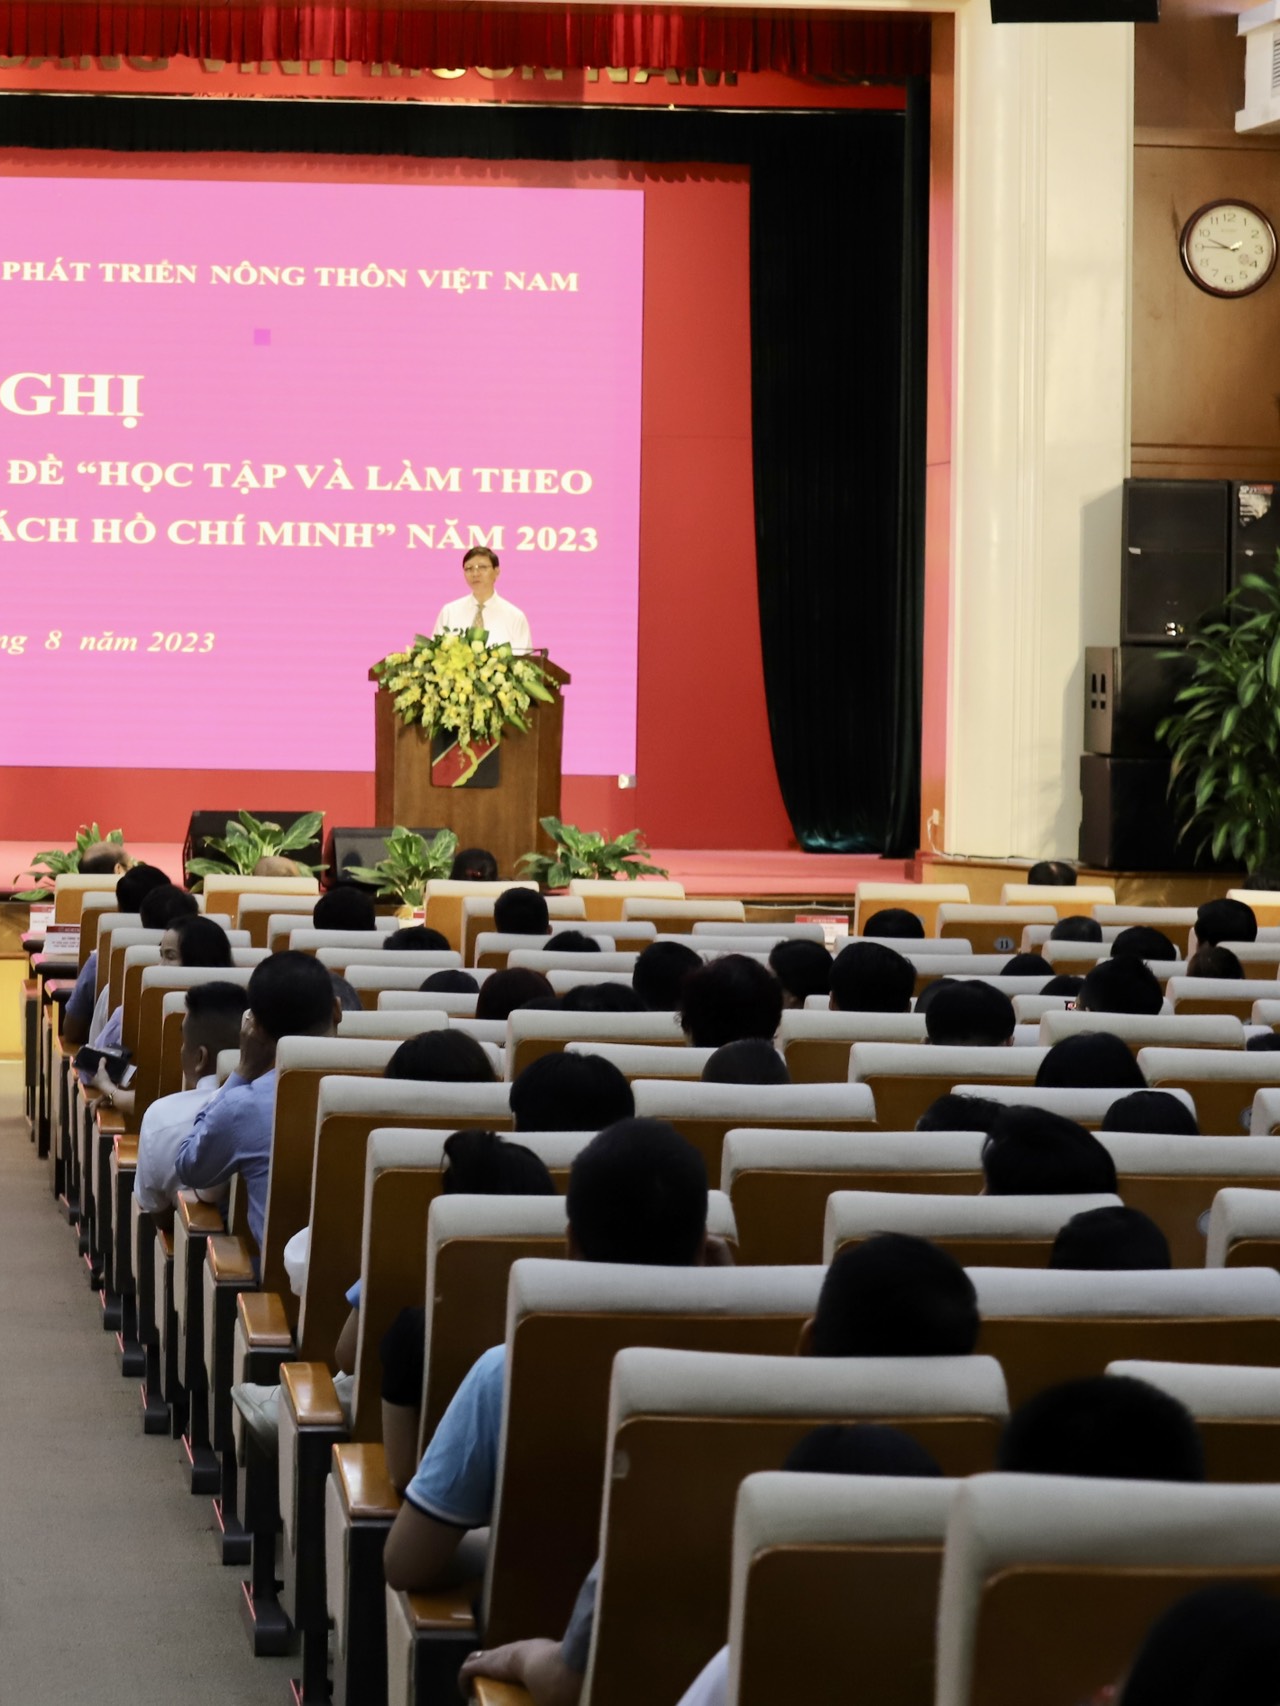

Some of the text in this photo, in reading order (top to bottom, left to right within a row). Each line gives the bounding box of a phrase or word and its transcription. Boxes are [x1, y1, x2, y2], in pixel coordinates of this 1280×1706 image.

[1, 256, 92, 282] PHÁT
[98, 259, 198, 284] TRIỂN
[210, 260, 306, 287] NÔNG
[313, 262, 408, 288] THÔN
[417, 266, 494, 295] VIỆT
[503, 270, 579, 293] NAM
[7, 452, 65, 486] ĐỀ
[202, 459, 288, 495] TẬP
[294, 457, 355, 491] VÀ
[365, 459, 463, 493] LÀM
[471, 467, 593, 495] THEO
[91, 511, 157, 545] HỒ
[166, 513, 246, 546] CHÍ
[406, 518, 505, 551] NĂM
[515, 525, 599, 553] 2023
[44, 629, 63, 650] 8
[79, 631, 138, 652] năm
[146, 631, 216, 653] 2023
